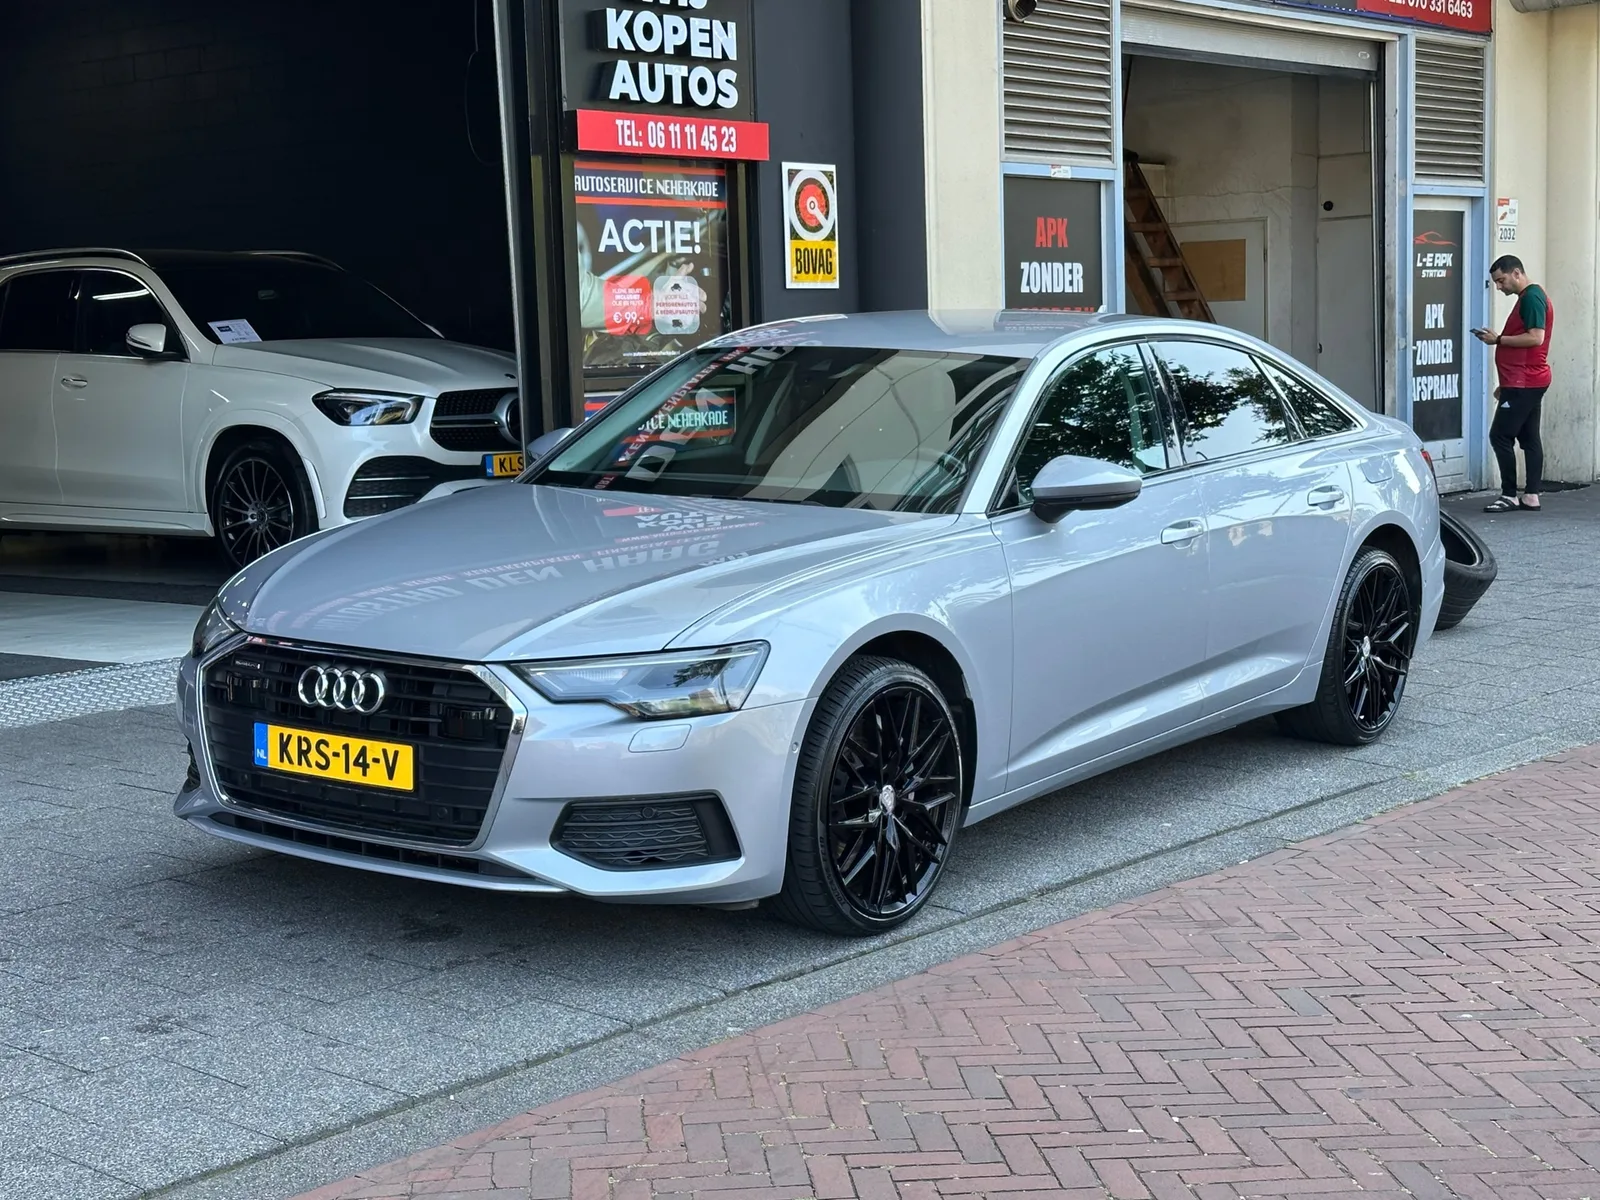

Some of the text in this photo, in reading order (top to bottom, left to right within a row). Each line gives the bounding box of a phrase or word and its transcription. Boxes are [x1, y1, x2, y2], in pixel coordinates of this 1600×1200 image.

[1429, 0, 1446, 13] 331
[1447, 0, 1473, 18] 6463
[606, 7, 738, 61] KOPEN
[608, 59, 739, 109] AUTOS
[615, 119, 737, 153] TEL: 06 11 11 45 23
[574, 175, 719, 197] AUTOSERVICE NEHERKADE
[598, 218, 702, 254] ACTIE!
[1035, 216, 1069, 248] APK
[1499, 227, 1516, 241] 2032
[795, 247, 833, 275] BOVAG
[1421, 269, 1447, 278] STATION
[1020, 261, 1084, 294] ZONDER
[613, 312, 623, 324] €
[1425, 304, 1445, 329] APK
[1416, 339, 1453, 366] ZONDER
[667, 409, 728, 429] NEHERKADE
[256, 748, 267, 759] NL
[279, 732, 400, 781] KRS-14-V
